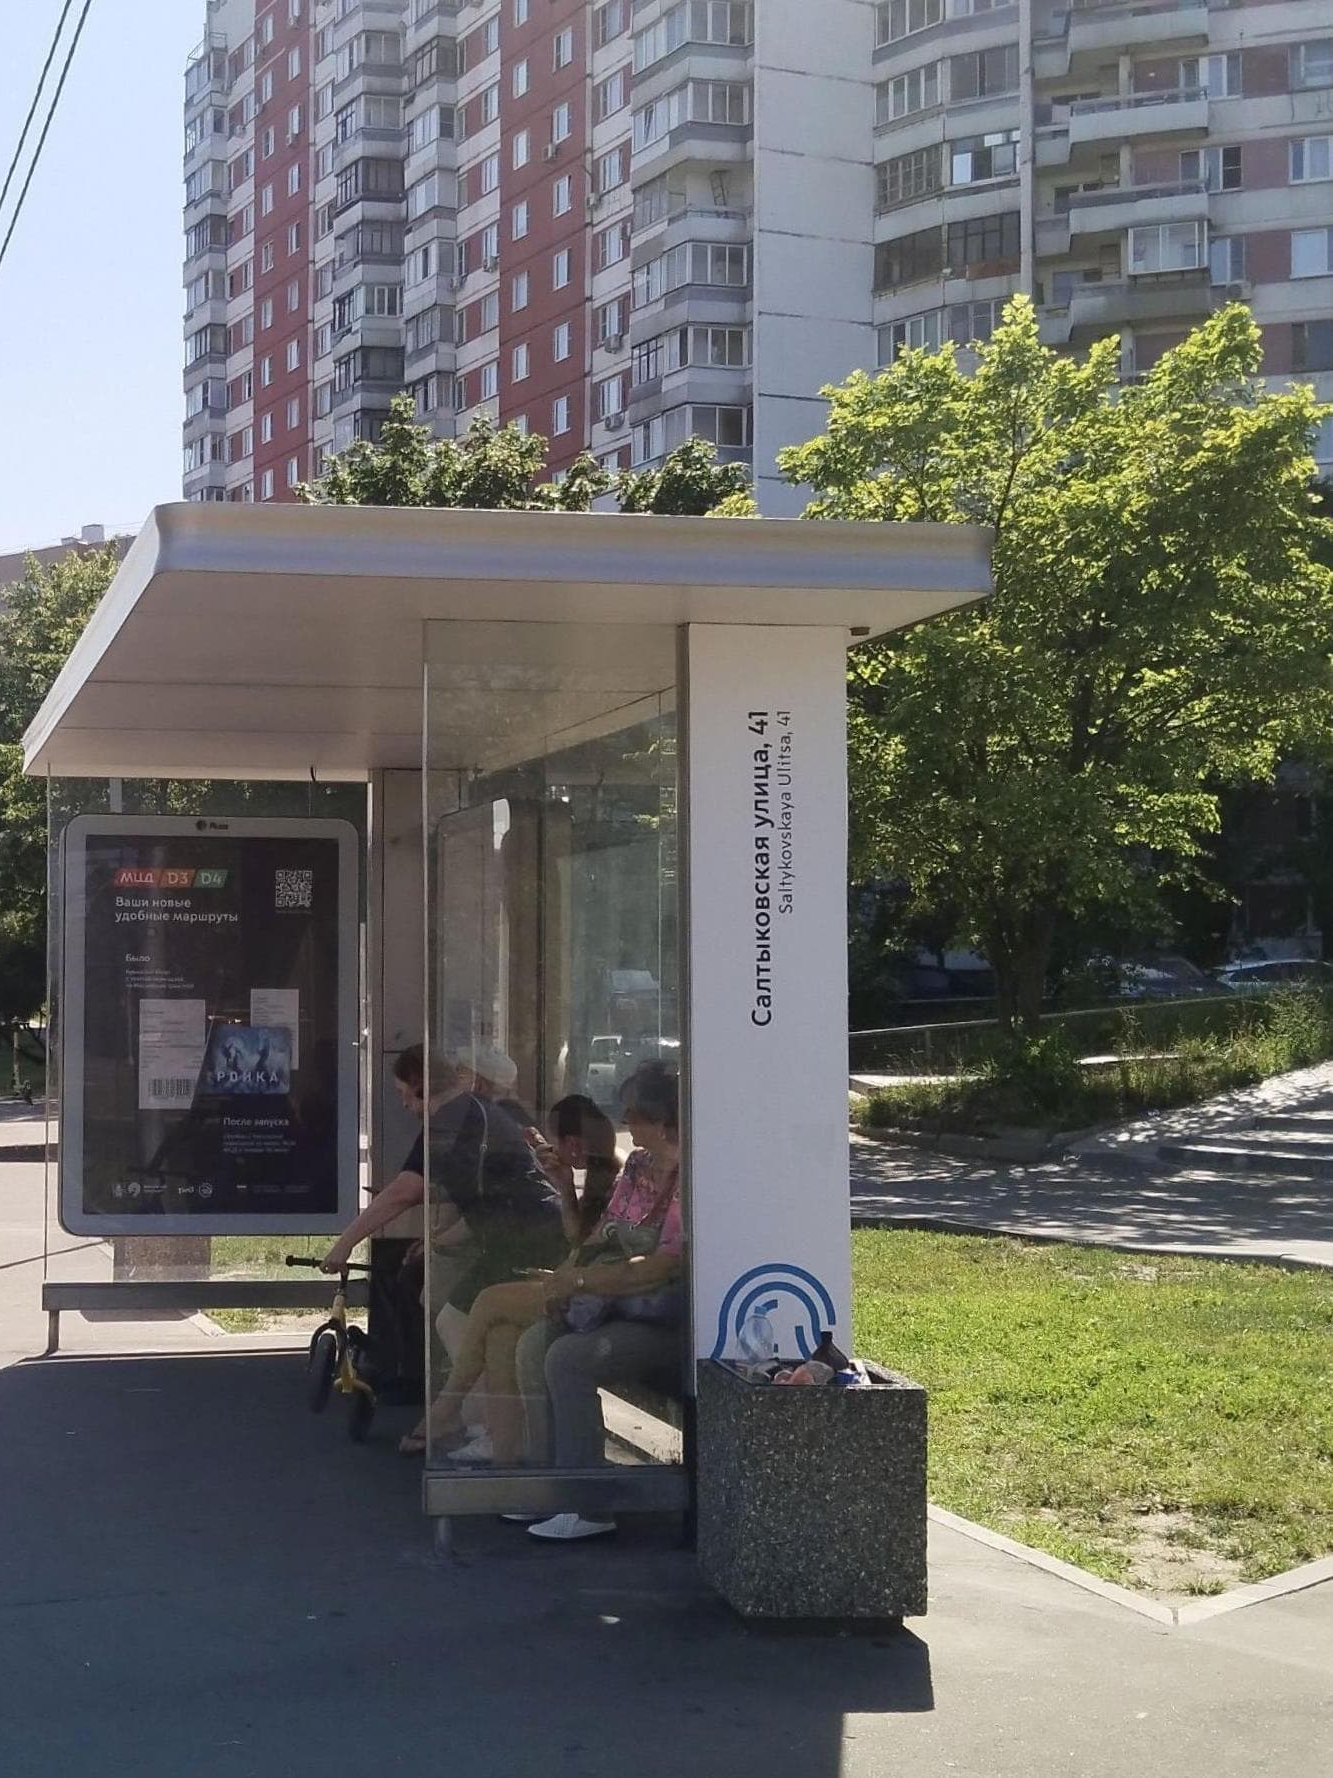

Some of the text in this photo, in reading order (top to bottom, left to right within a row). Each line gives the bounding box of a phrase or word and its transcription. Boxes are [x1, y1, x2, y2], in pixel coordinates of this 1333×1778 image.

[777, 711, 795, 914] Saltykovskaya Ulitsa, 41
[748, 711, 774, 1026] Салтыковская улица, 41
[119, 872, 222, 884] МЦД D3 D4
[115, 896, 192, 908] Ваши новые
[115, 910, 238, 924] удобные маршруты
